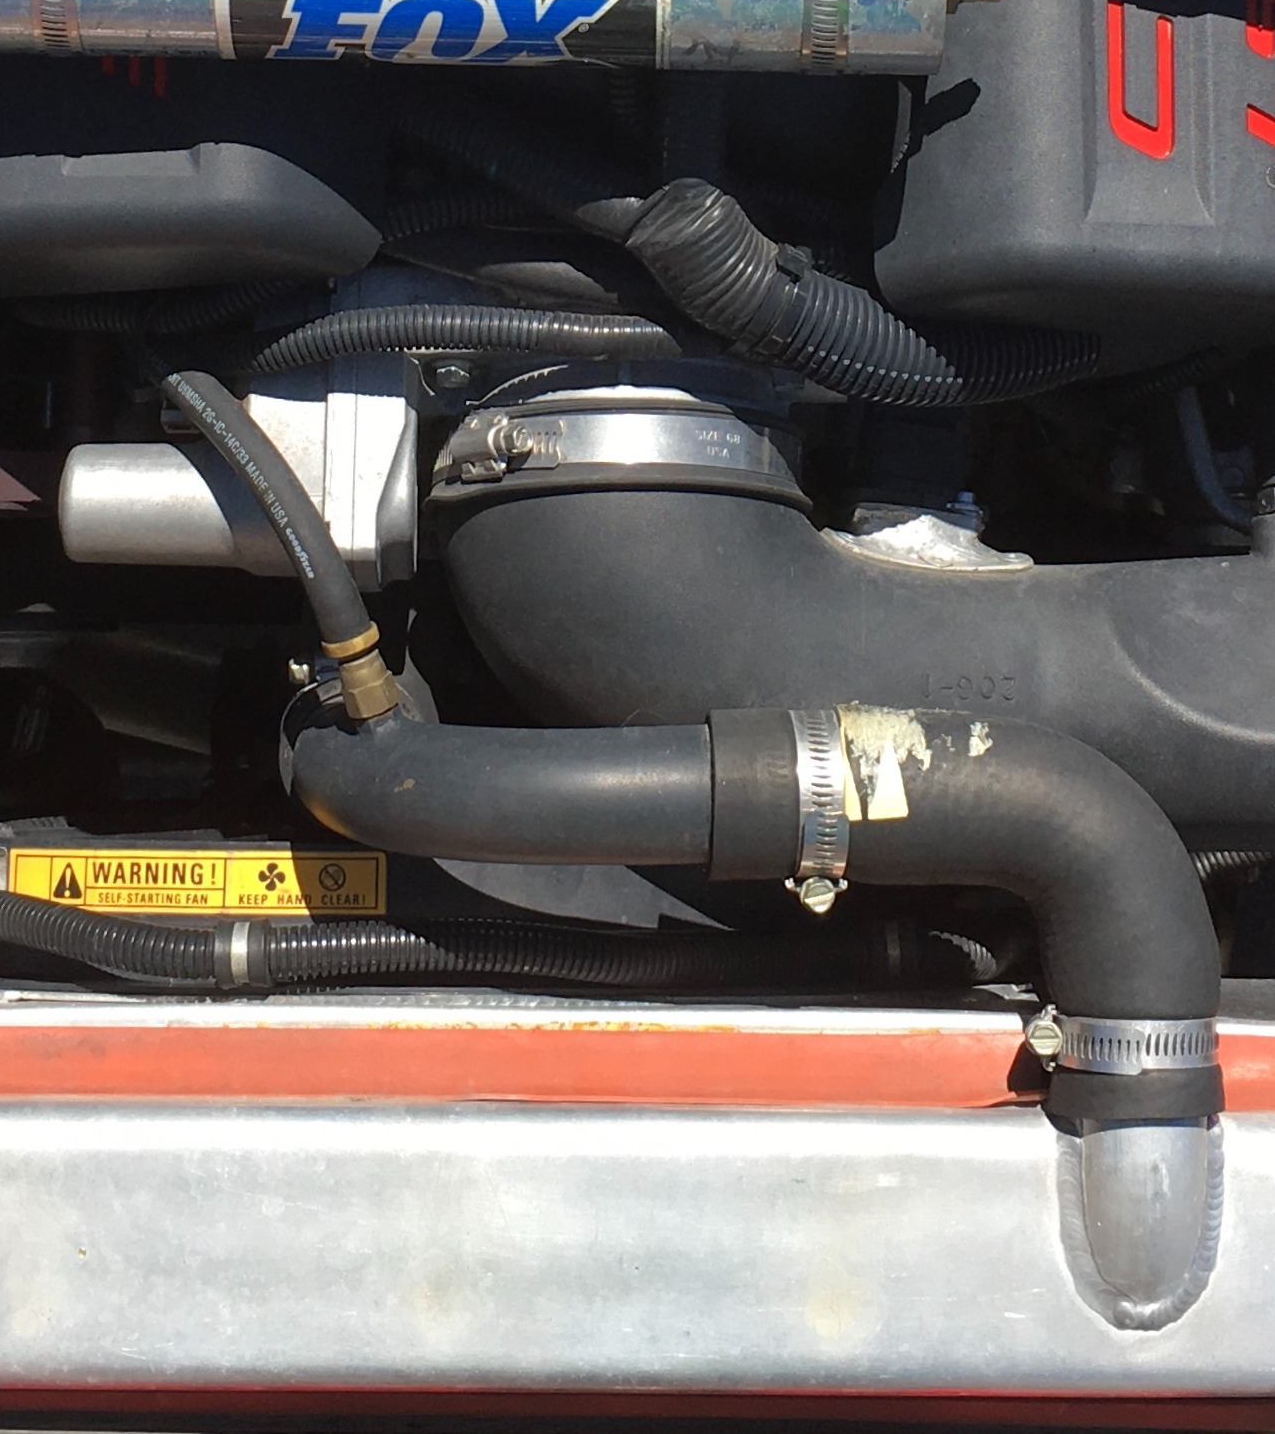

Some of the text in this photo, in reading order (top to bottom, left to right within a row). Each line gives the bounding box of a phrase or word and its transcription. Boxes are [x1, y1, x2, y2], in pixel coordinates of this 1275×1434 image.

[245, 461, 270, 490] MADE
[270, 501, 289, 528] USA
[98, 891, 209, 906] SELF-STARTING FAN
[238, 893, 269, 906] KEEP
[276, 893, 312, 906] HAND
